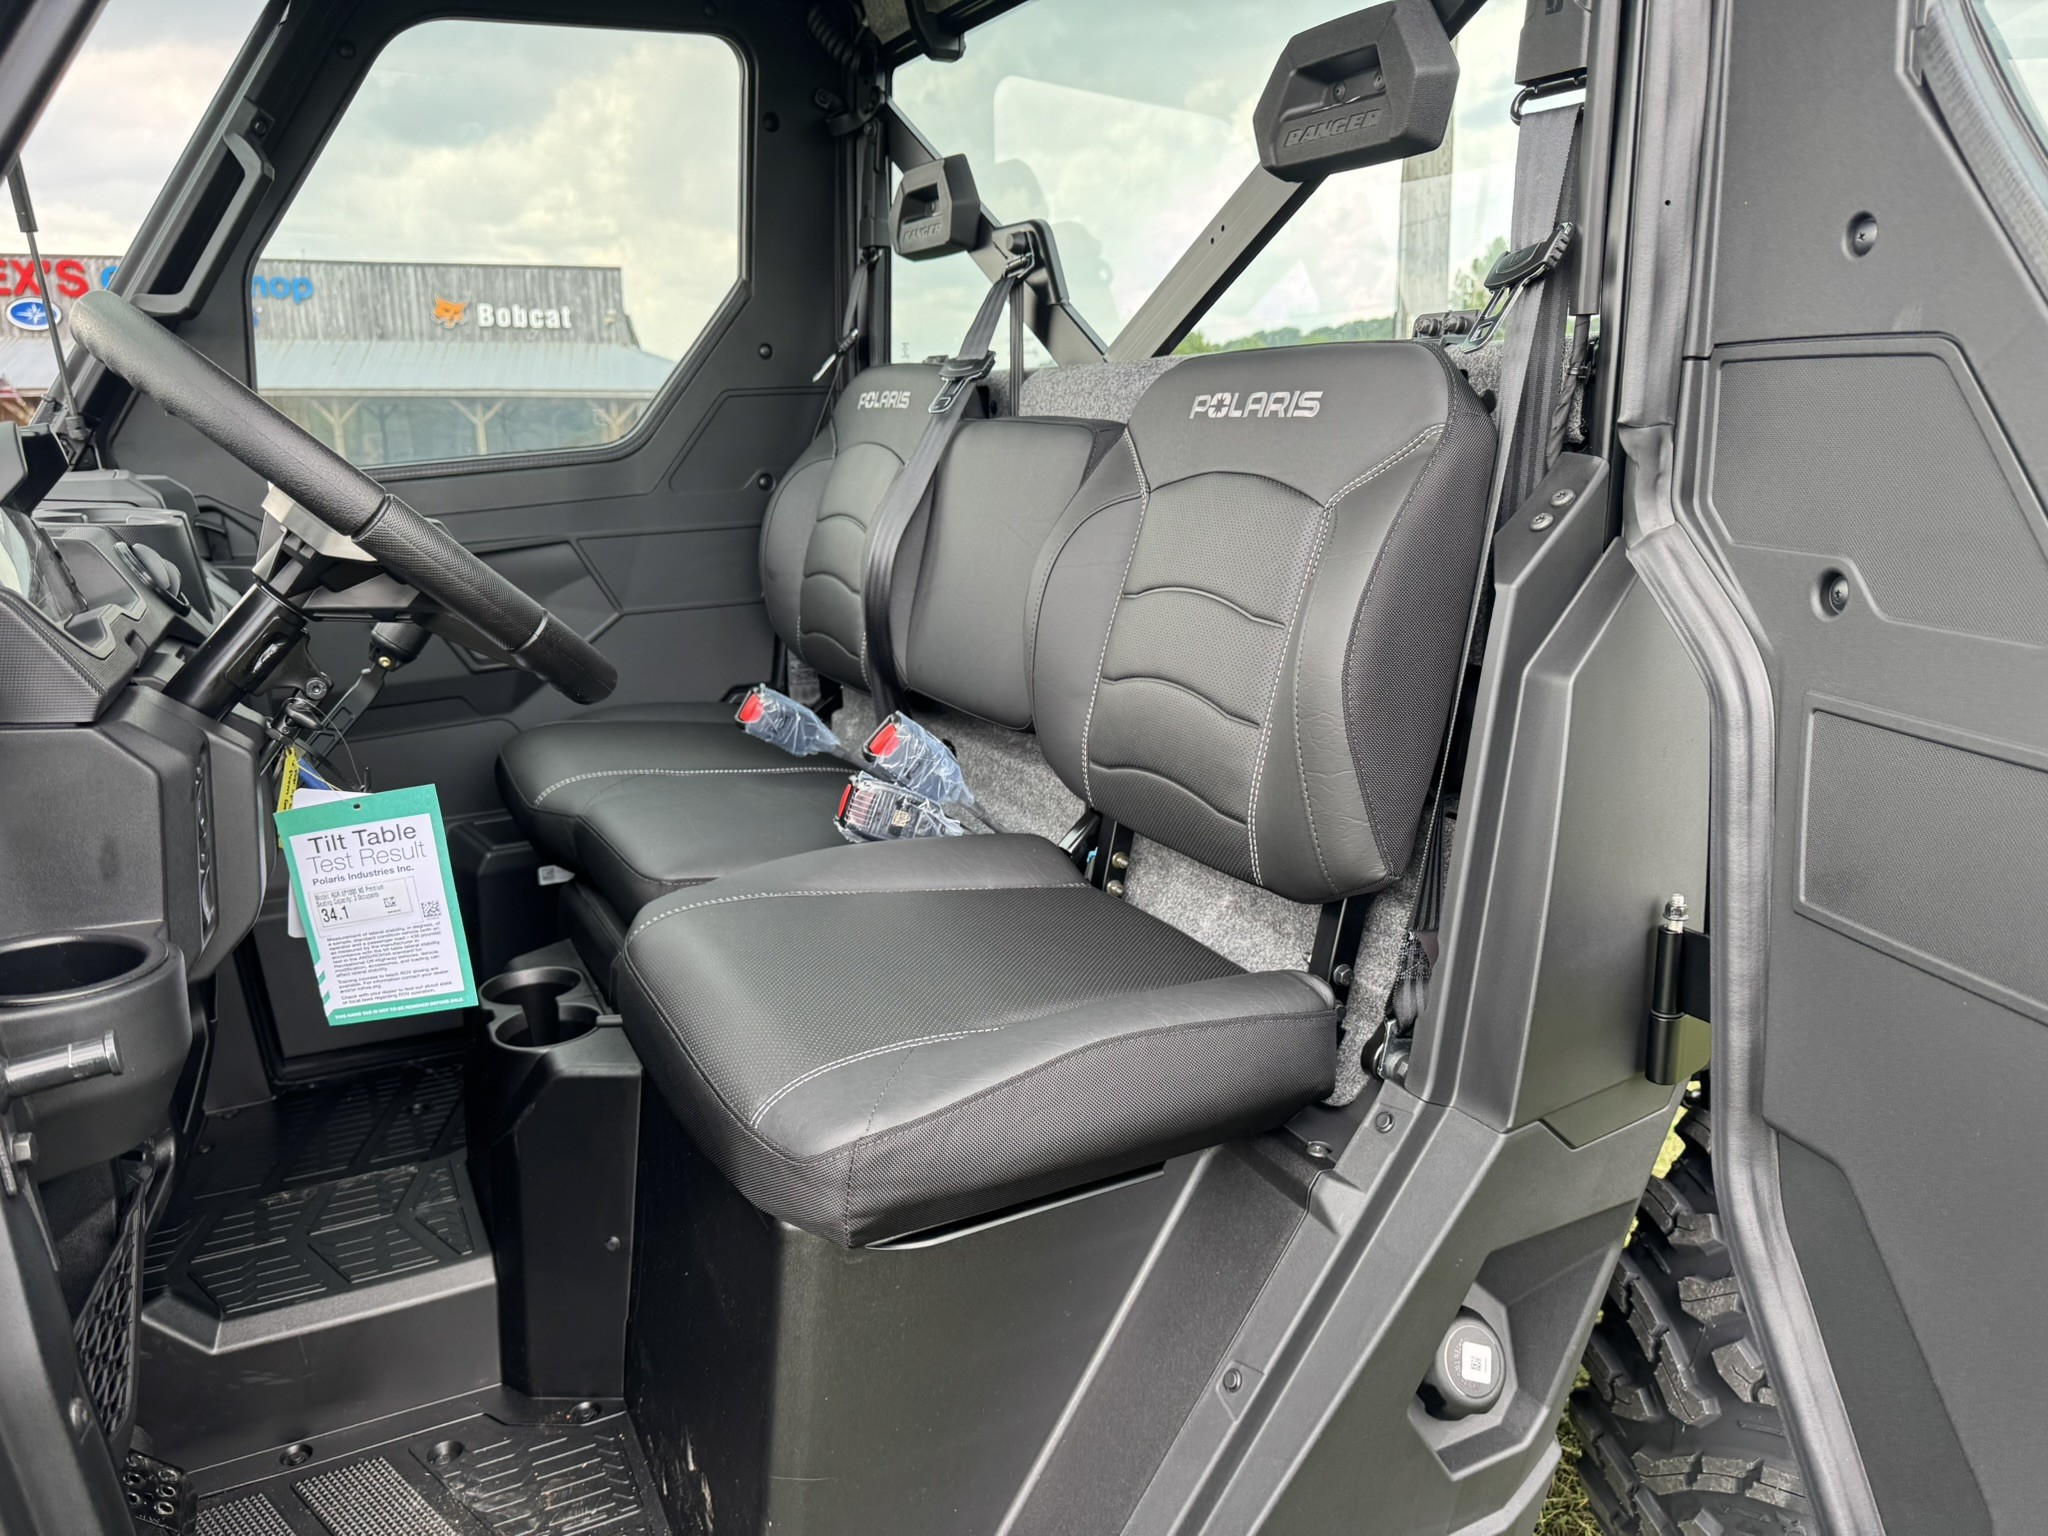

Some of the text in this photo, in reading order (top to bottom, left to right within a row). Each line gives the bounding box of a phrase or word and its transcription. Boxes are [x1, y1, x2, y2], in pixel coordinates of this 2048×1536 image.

[1284, 108, 1382, 148] RANGER
[477, 302, 572, 329] Bobcat
[857, 390, 911, 409] POLARIS
[1189, 391, 1324, 419] POLARIS
[307, 823, 417, 854] Tilt Table
[306, 840, 427, 874] Test Result
[312, 865, 415, 886] Polaris Industries Inc.
[321, 905, 349, 923] 34.1
